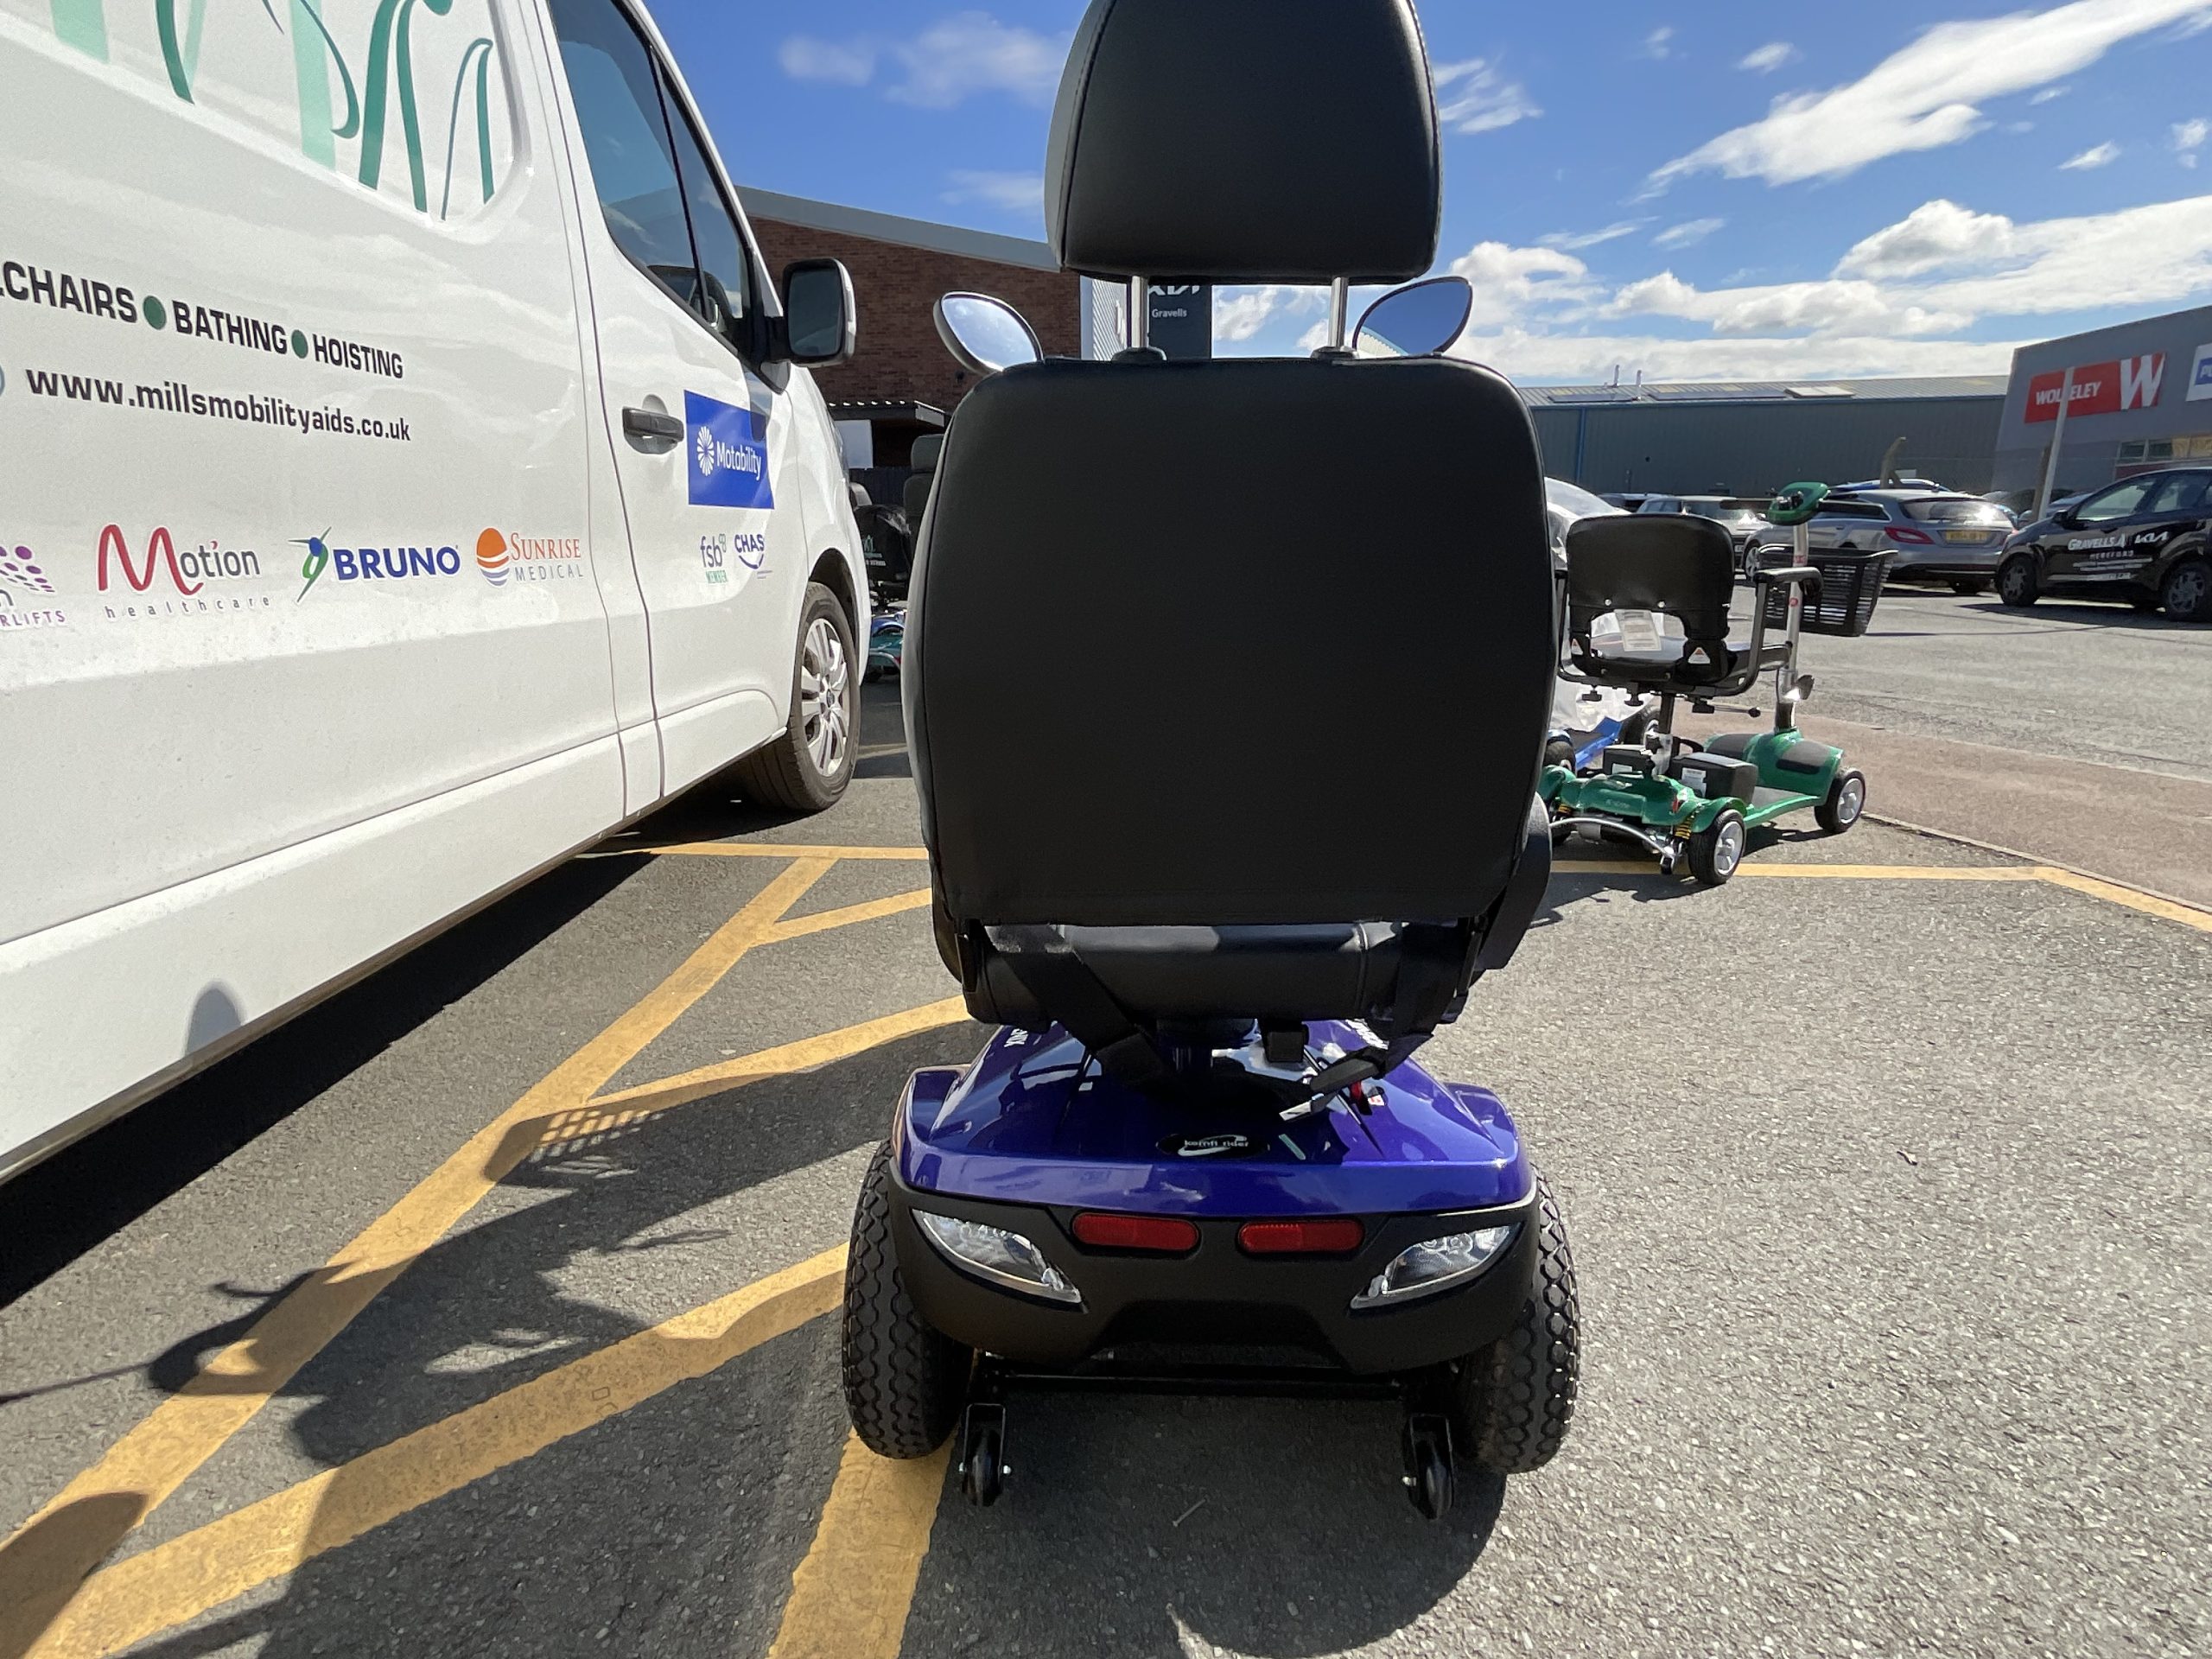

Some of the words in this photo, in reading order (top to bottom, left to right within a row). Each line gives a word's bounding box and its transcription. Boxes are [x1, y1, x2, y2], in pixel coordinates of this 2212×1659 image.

[0, 260, 138, 324] CHAIRS
[172, 300, 289, 355] BATHING
[312, 334, 404, 379] HOISTING
[1151, 308, 1188, 318] Gravells
[26, 368, 411, 442] www.millsmobilityaids.co.uk
[2035, 381, 2101, 405] WOLELEY
[716, 441, 762, 481] Motability
[510, 531, 582, 561] SUNRISE
[700, 535, 723, 568] fsb
[734, 533, 766, 553] CHAS
[2068, 537, 2116, 550] GRAVELLS
[98, 524, 261, 595] Motion
[333, 546, 461, 581] BRUNO
[514, 564, 584, 582] MEDICAL
[105, 594, 270, 620] healthcare
